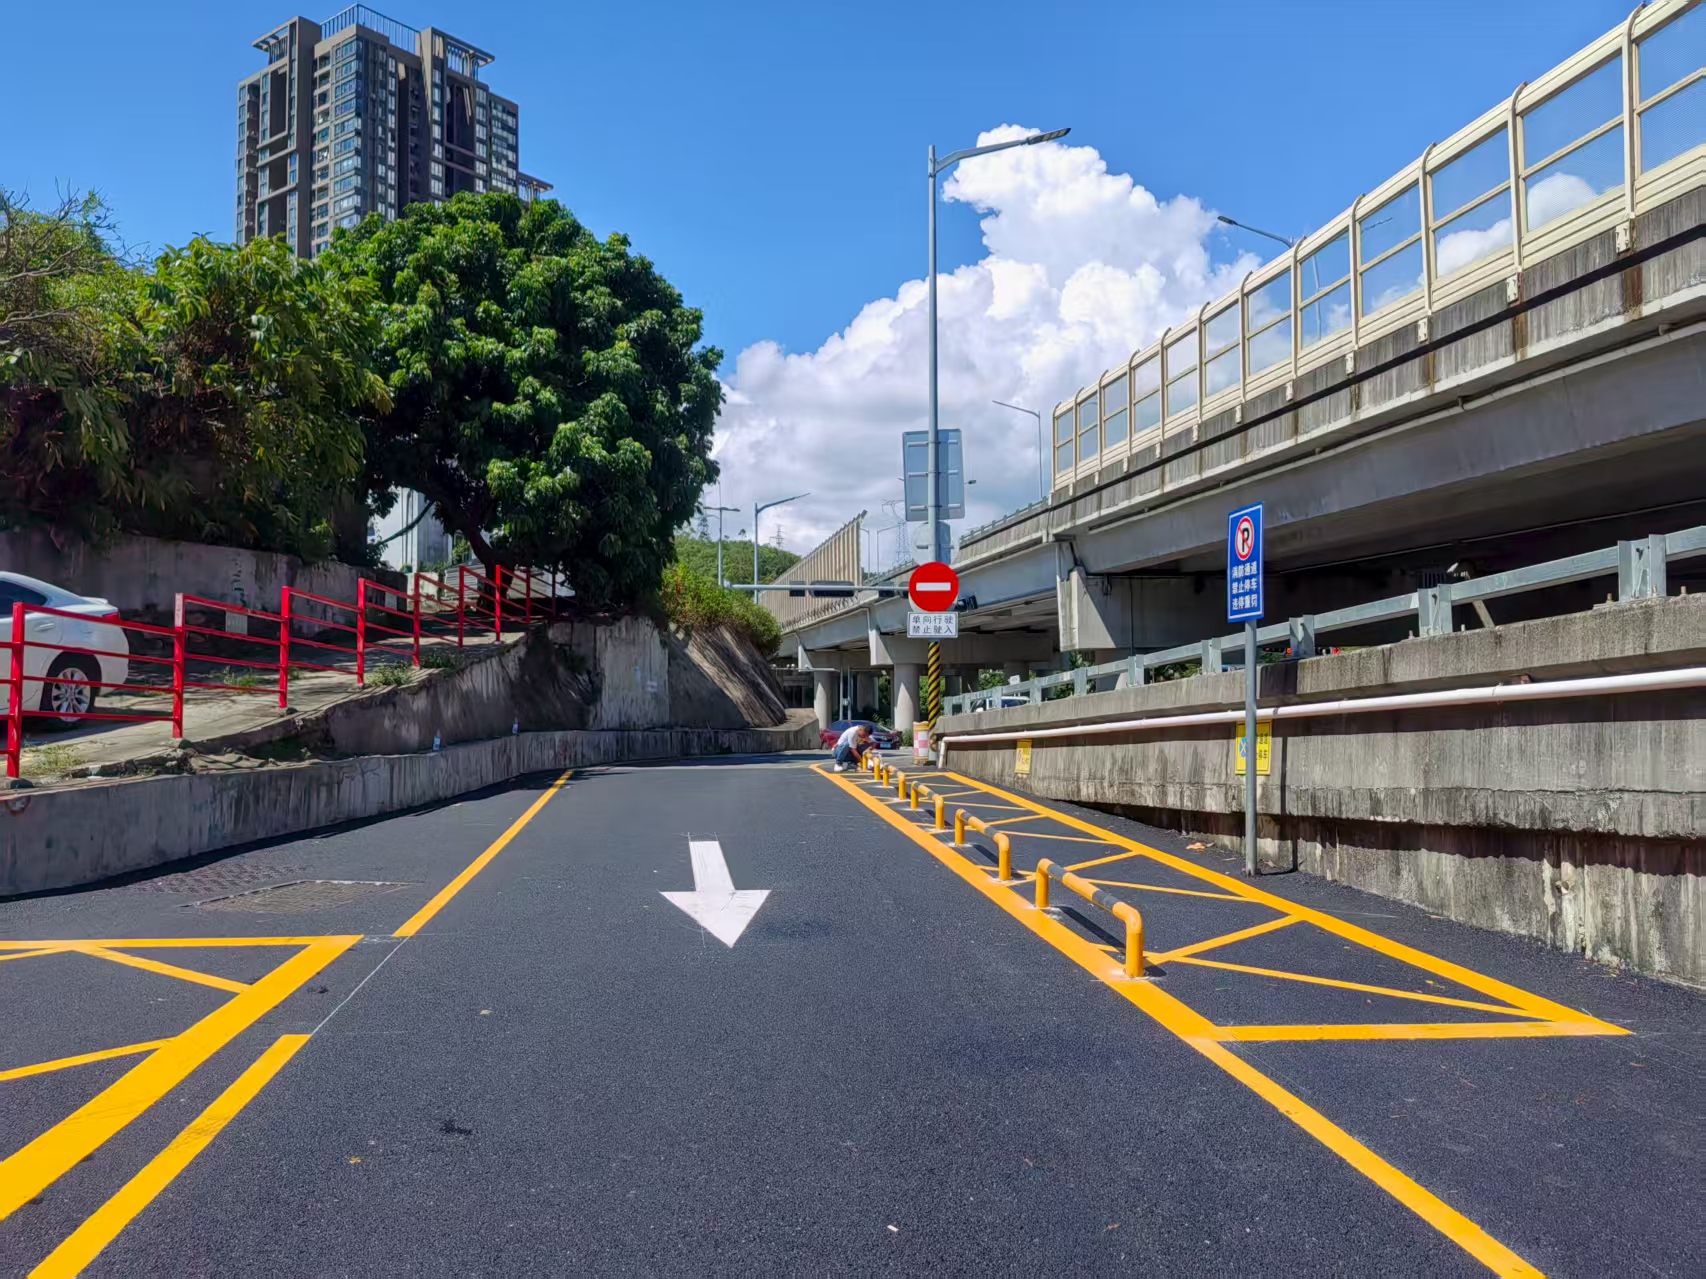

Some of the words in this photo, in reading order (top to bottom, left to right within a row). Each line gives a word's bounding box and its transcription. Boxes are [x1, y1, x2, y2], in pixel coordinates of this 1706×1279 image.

[1232, 561, 1257, 579] 消防通道
[1232, 578, 1257, 594] 禁止停车
